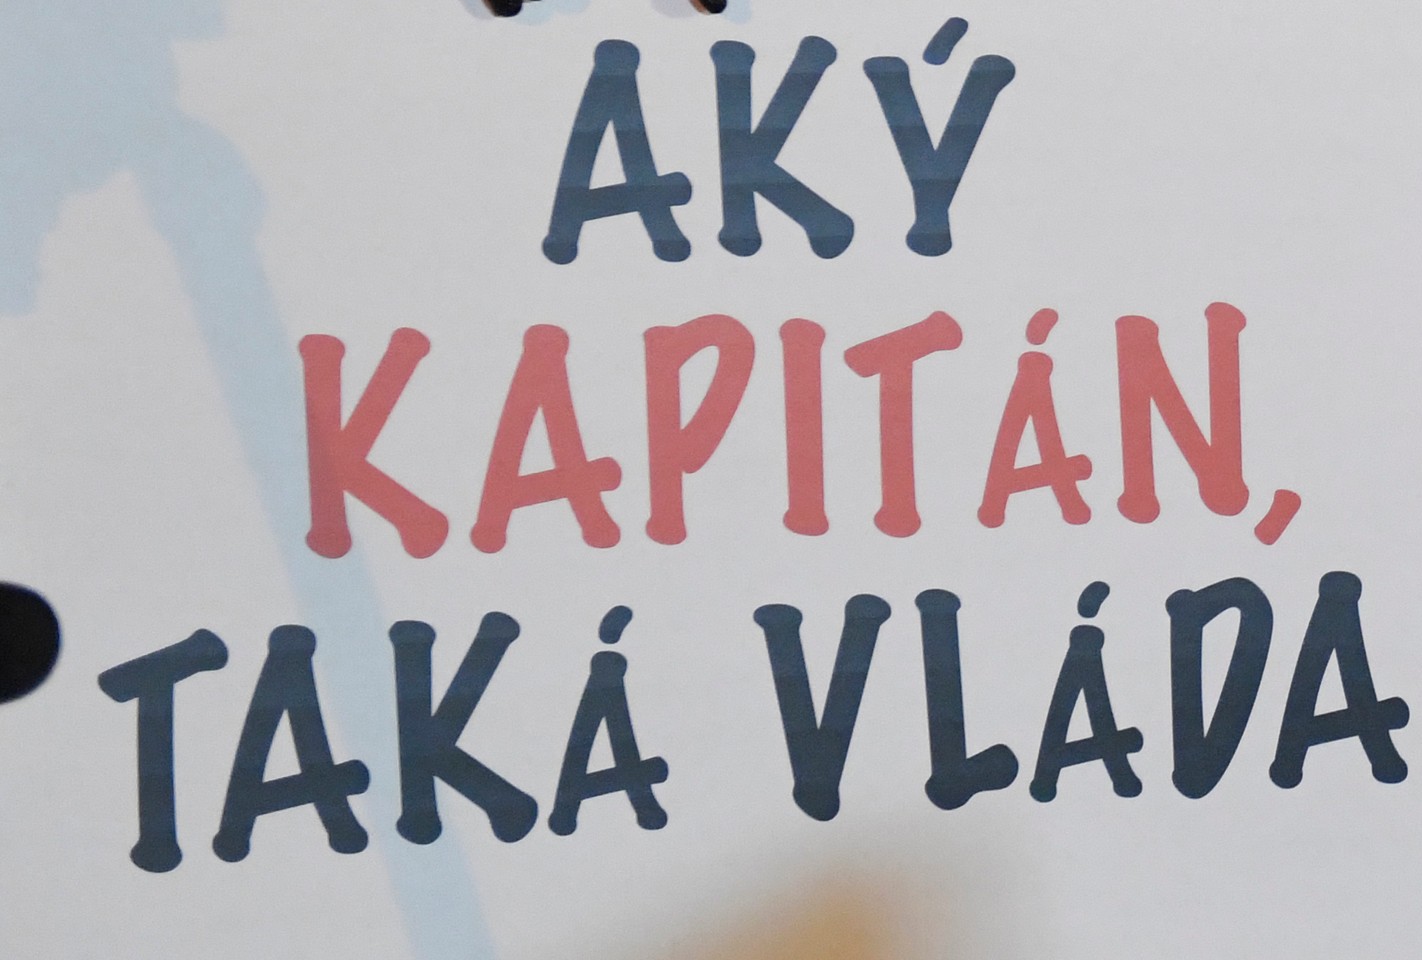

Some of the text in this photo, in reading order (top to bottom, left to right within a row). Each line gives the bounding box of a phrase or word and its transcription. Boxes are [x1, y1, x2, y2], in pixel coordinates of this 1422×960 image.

[541, 17, 1016, 266] AKÝ
[298, 301, 1302, 560] KAPITÁN,
[97, 570, 1411, 874] TAKÁ VLÁDA
